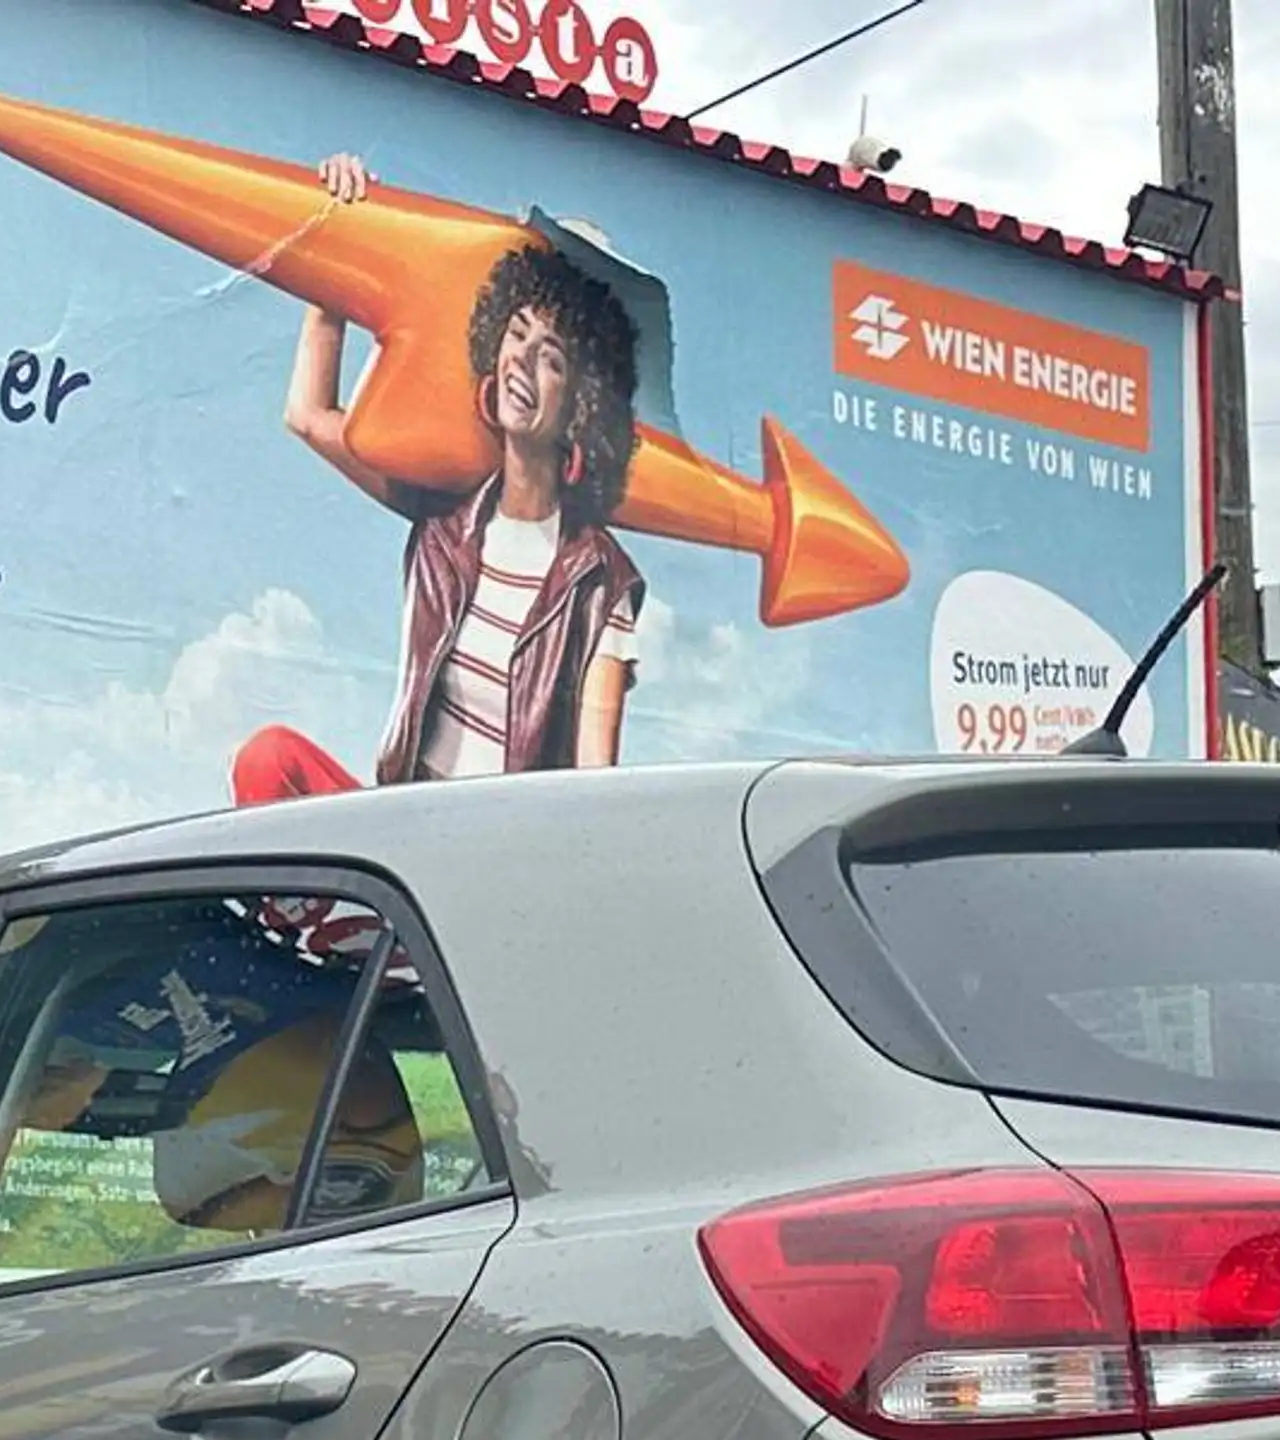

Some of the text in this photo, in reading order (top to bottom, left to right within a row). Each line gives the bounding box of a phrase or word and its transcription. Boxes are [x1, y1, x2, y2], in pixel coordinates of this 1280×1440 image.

[921, 320, 1137, 415] WIEN ENERGIE
[833, 389, 1152, 500] DIE ENERGIE VON WIEN
[953, 652, 1110, 693] Strom jetzt nur
[956, 703, 1028, 754] 9,99
